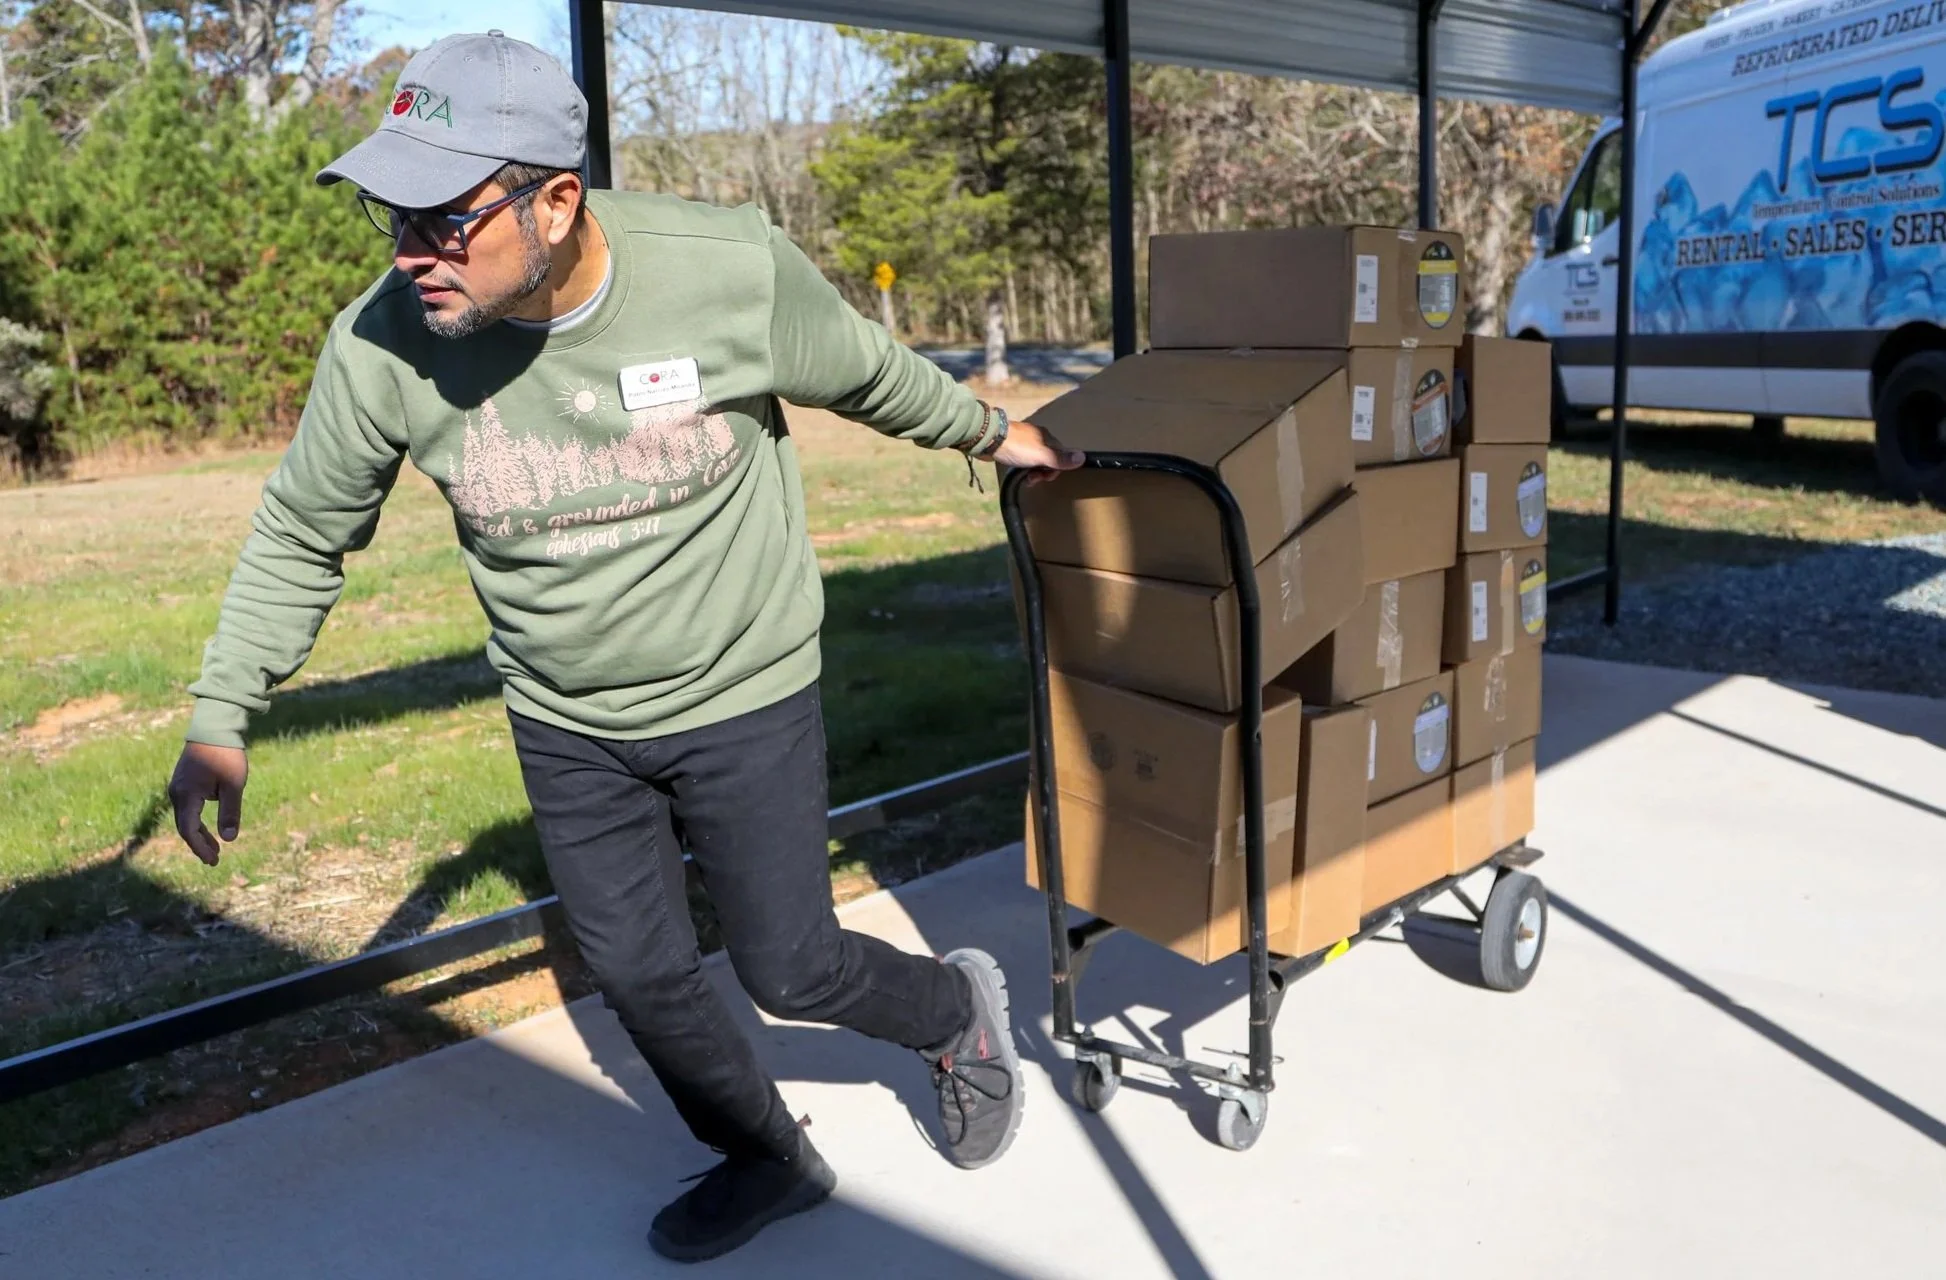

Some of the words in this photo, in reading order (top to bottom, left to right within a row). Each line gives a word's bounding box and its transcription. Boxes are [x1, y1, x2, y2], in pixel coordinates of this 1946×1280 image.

[1732, 18, 1879, 77] REFRIGERATED
[1766, 66, 1944, 193] TCS
[1826, 192, 1874, 211] Control
[1877, 183, 1940, 205] Solutions
[1677, 232, 1765, 266] RENTAL
[1785, 220, 1866, 257] SALES
[1892, 212, 1946, 247] SER
[522, 518, 539, 535] &
[547, 486, 659, 538] grounded
[669, 485, 693, 504] in
[546, 526, 621, 560] ephesians
[631, 516, 661, 541] 3:17
